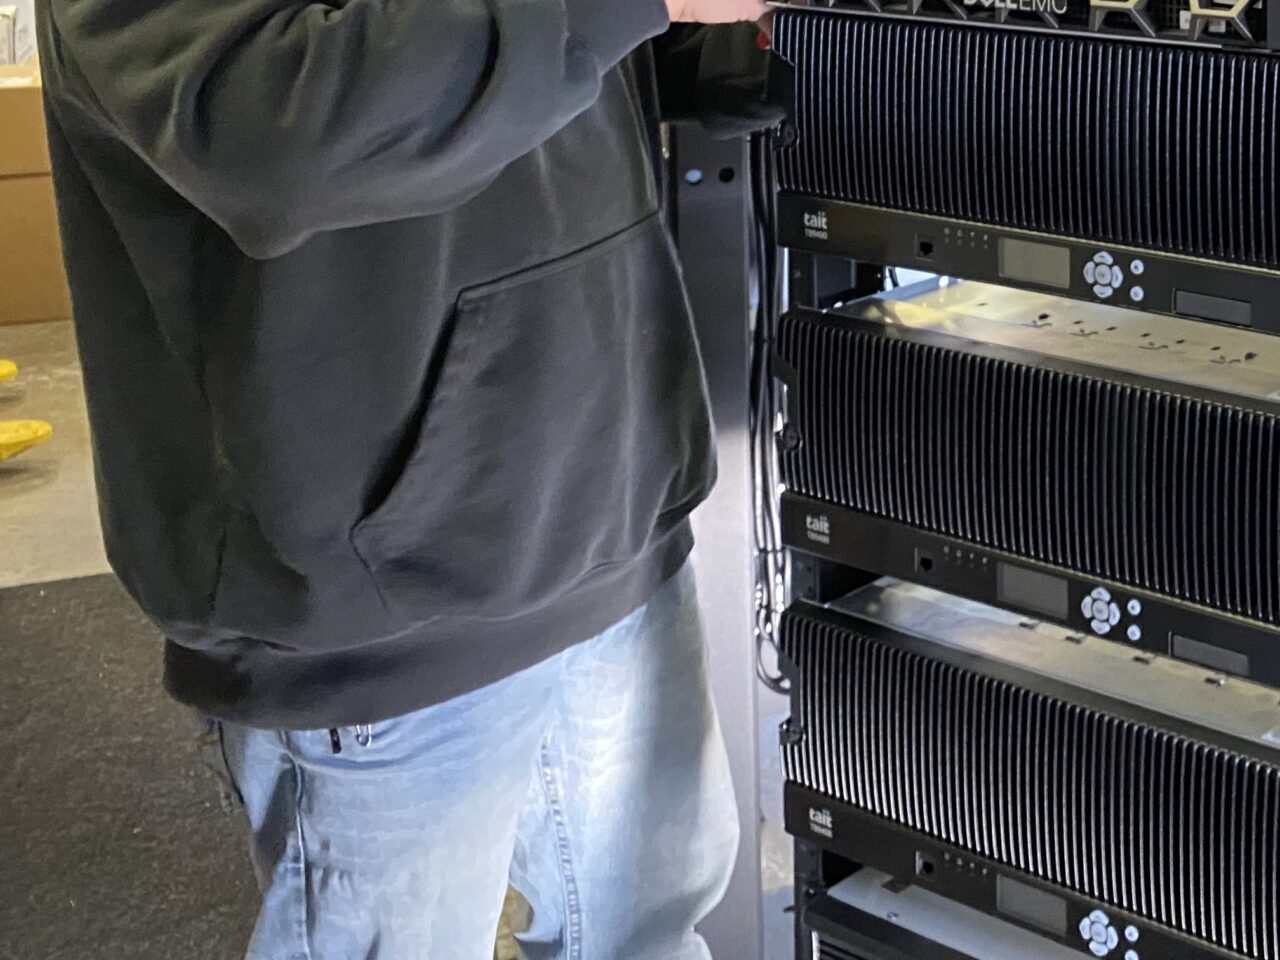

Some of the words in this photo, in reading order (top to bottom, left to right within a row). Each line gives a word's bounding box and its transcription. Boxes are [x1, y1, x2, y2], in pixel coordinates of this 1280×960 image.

[804, 211, 828, 230] tait
[806, 514, 830, 535] tait
[809, 807, 833, 828] tait
